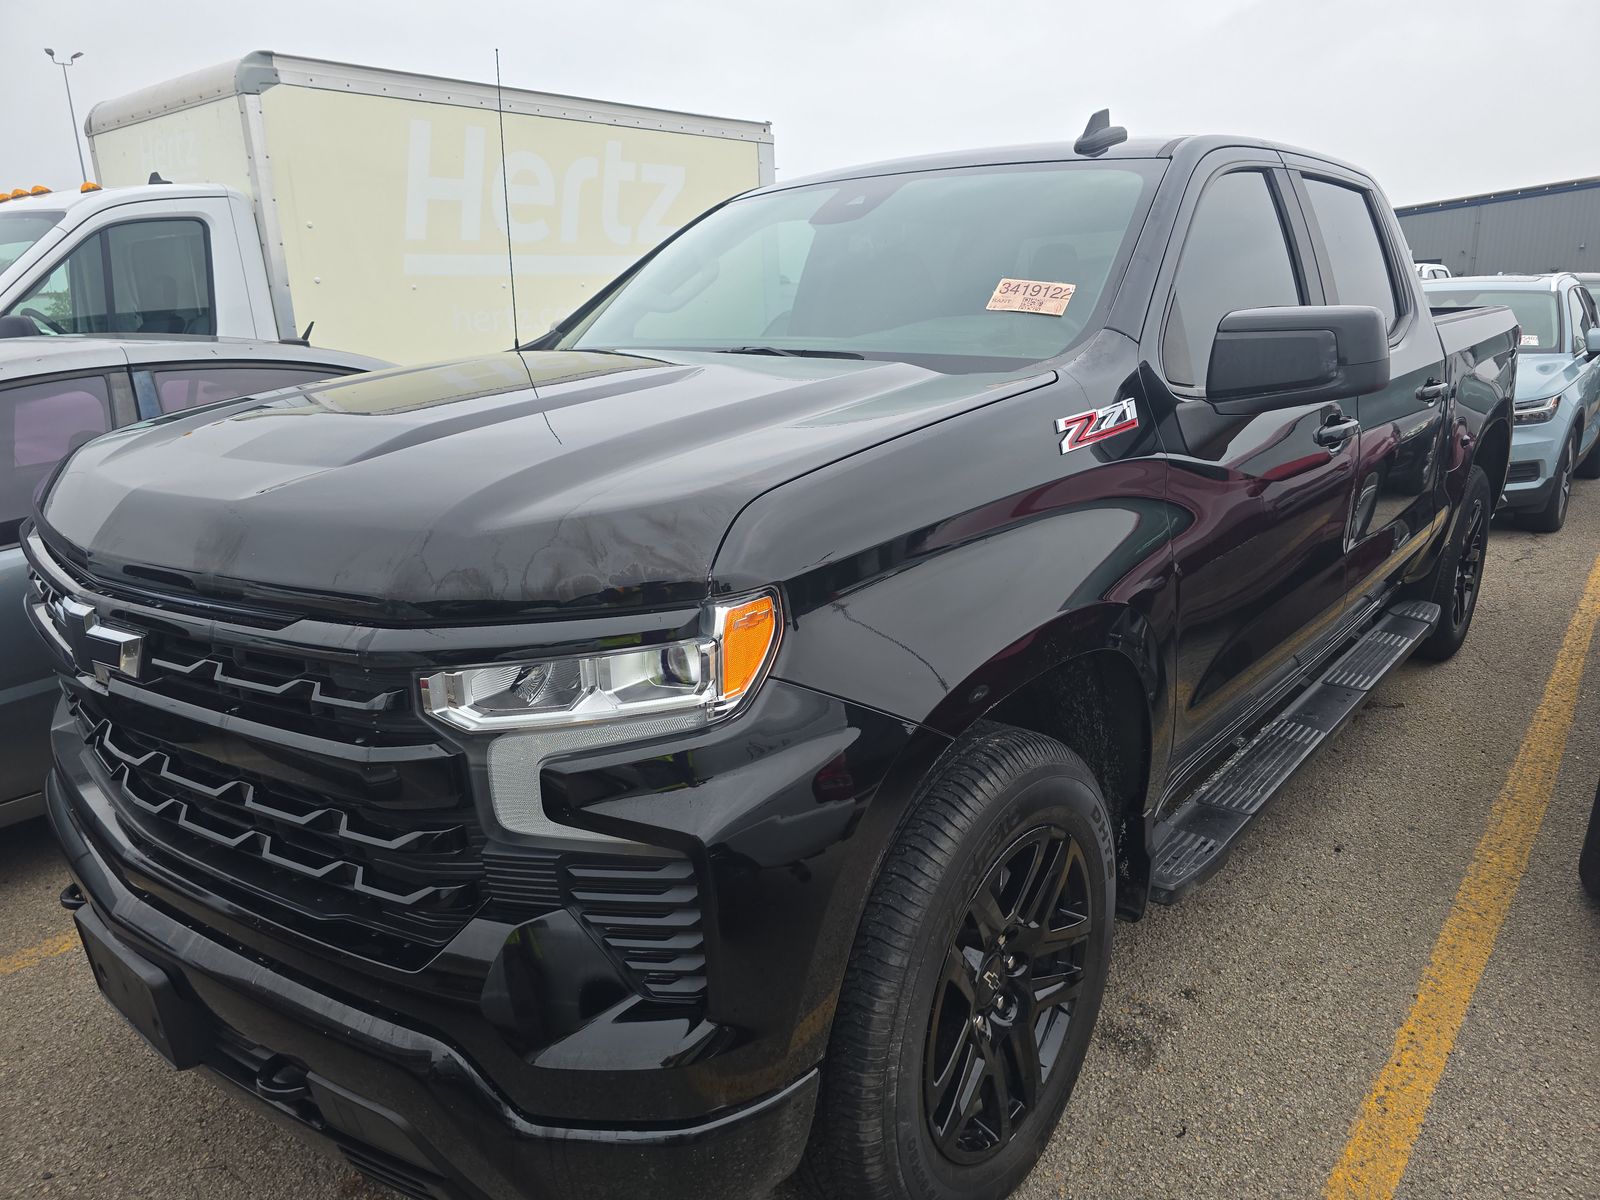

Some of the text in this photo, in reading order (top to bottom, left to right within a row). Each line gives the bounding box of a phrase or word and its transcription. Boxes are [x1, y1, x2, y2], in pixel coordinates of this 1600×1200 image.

[140, 130, 197, 169] Hertz
[404, 119, 686, 246] Hertz
[999, 281, 1073, 301] 3419122
[1054, 397, 1139, 456] Z71
